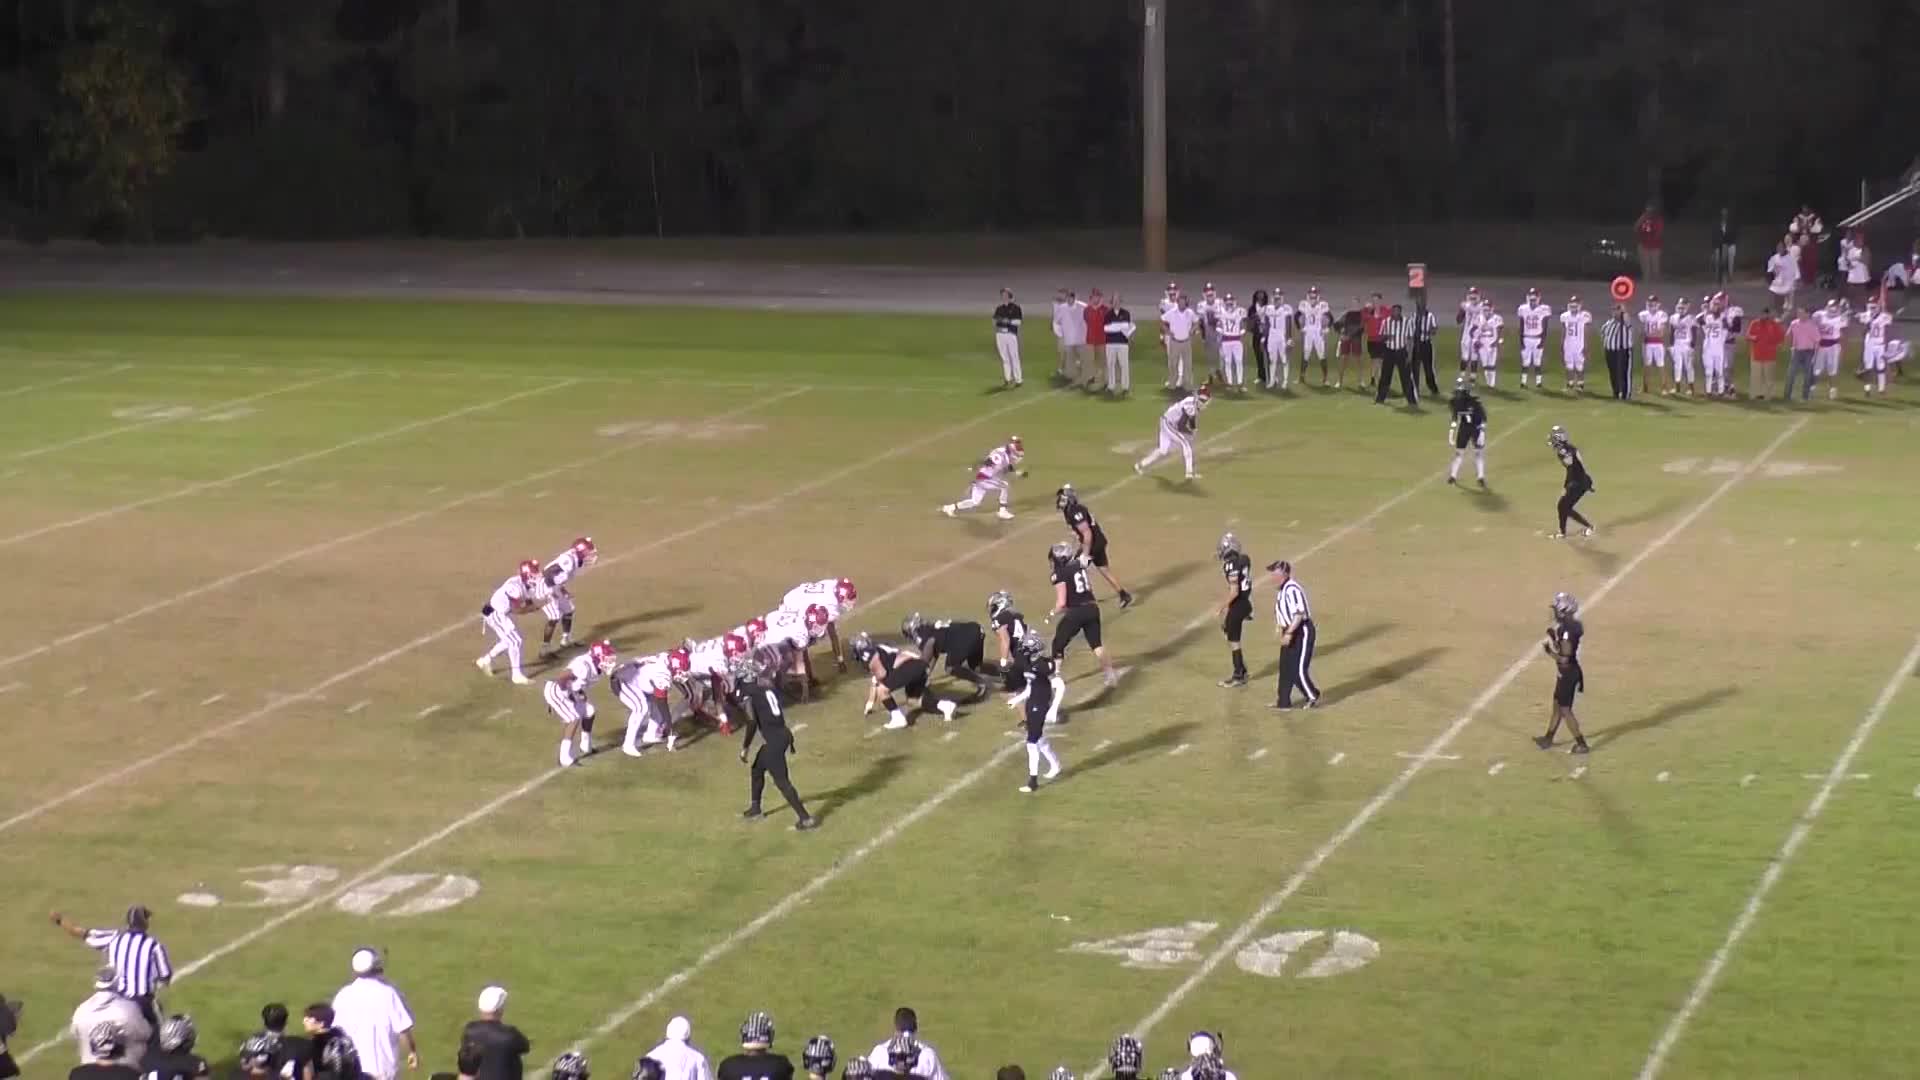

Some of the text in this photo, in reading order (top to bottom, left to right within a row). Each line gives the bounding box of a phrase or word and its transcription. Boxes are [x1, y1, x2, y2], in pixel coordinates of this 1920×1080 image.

[1567, 321, 1579, 336] 51
[1705, 323, 1721, 338] 75
[1073, 568, 1091, 594] 61
[765, 689, 782, 717] 0
